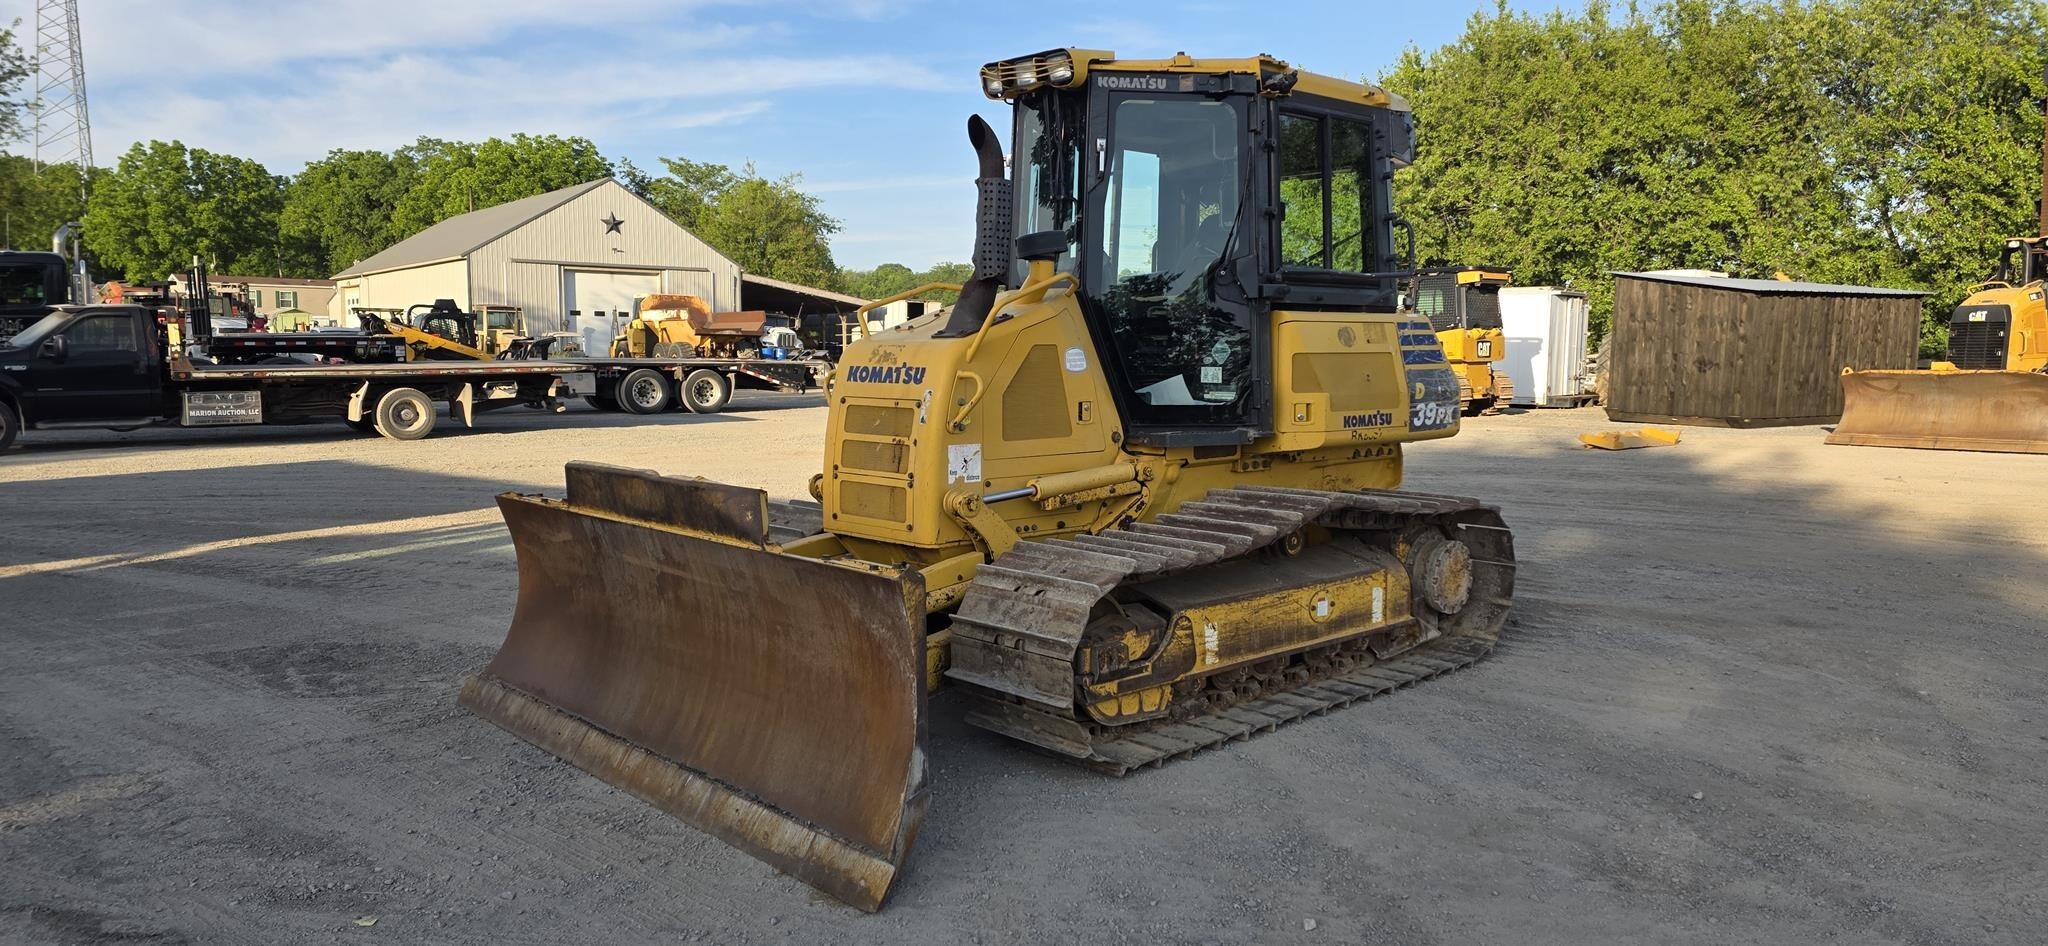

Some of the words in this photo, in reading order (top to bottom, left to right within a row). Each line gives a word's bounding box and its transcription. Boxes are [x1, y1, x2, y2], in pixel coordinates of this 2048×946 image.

[1097, 75, 1167, 90] KOMATSU
[1968, 310, 1988, 322] CAT
[1478, 341, 1491, 357] CAT
[847, 362, 926, 385] KOMATSU
[1415, 382, 1425, 400] D
[1343, 410, 1393, 428] KOMATSU
